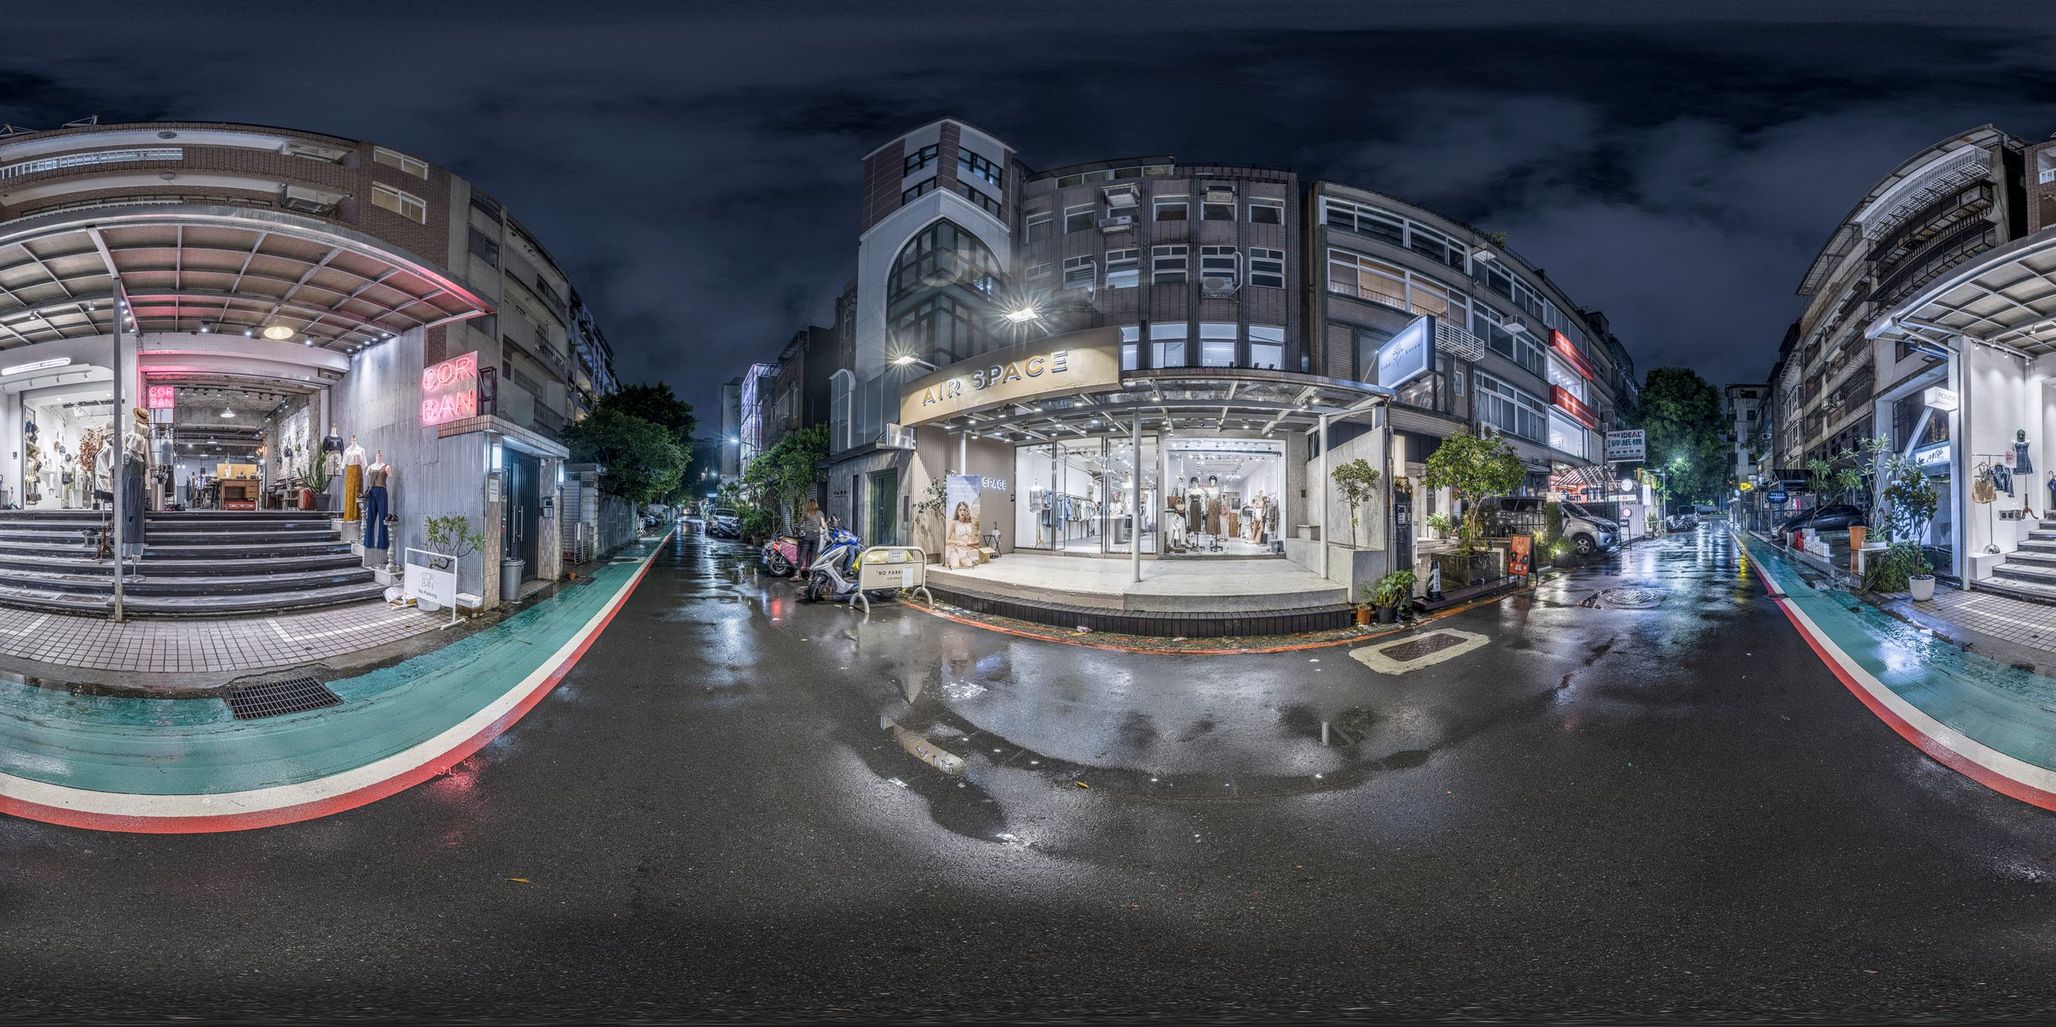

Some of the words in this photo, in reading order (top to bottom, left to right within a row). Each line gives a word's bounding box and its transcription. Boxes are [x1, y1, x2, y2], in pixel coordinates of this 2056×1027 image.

[423, 358, 474, 391] COR
[923, 378, 961, 406] AIR
[971, 350, 1069, 390] SPACE
[150, 387, 172, 396] COR
[150, 398, 172, 407] BAN
[423, 390, 473, 421] BAN
[1621, 431, 1642, 439] IDEAL
